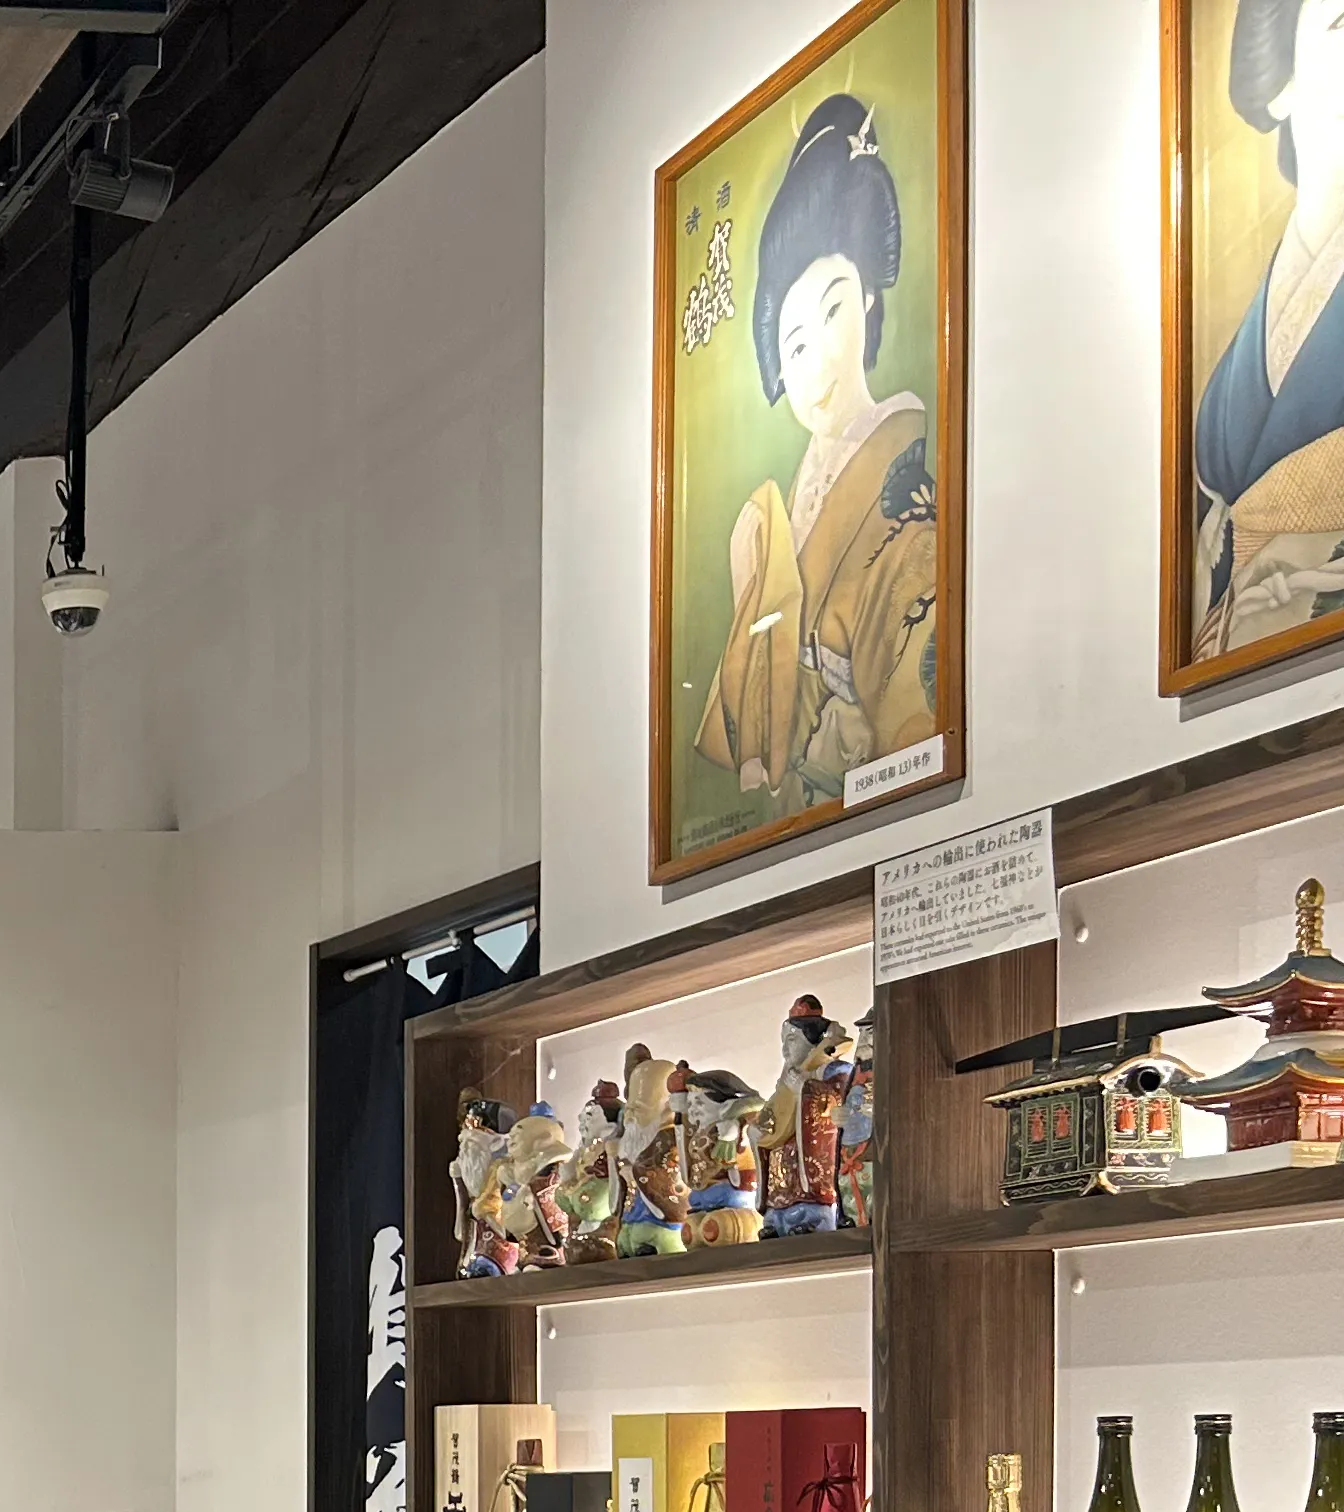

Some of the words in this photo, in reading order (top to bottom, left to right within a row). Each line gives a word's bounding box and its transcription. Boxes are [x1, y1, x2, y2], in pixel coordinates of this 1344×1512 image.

[682, 218, 736, 356] 賀茂鶴
[881, 819, 1042, 887] アメリカへの輸出に使われた陶器
